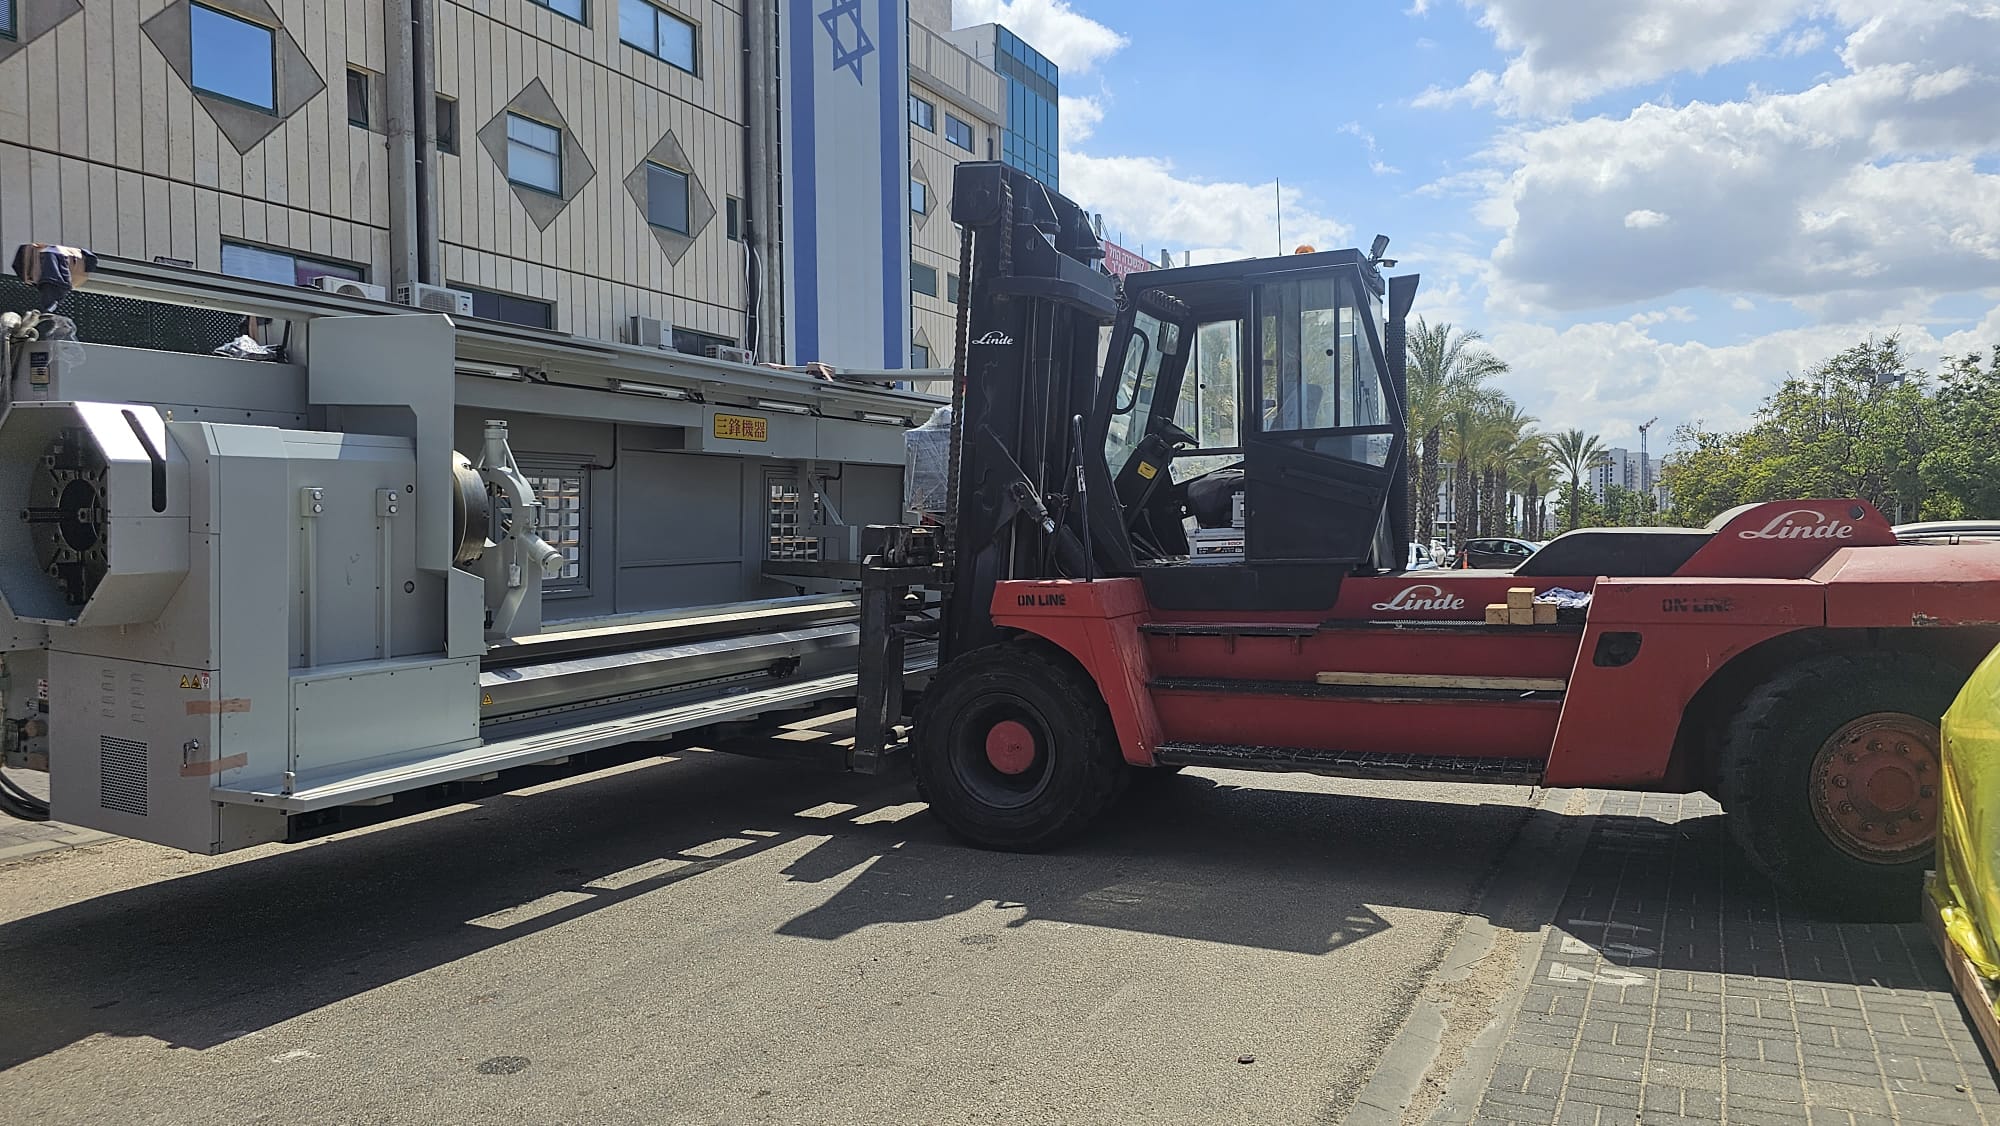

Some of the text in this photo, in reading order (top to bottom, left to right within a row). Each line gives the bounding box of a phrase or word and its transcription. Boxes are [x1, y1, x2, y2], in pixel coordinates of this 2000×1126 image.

[971, 330, 1014, 345] Linde
[716, 417, 766, 438] 三鋒機器
[1738, 509, 1853, 539] Linde
[1017, 594, 1067, 606] ON LINE
[1371, 584, 1465, 611] Linde
